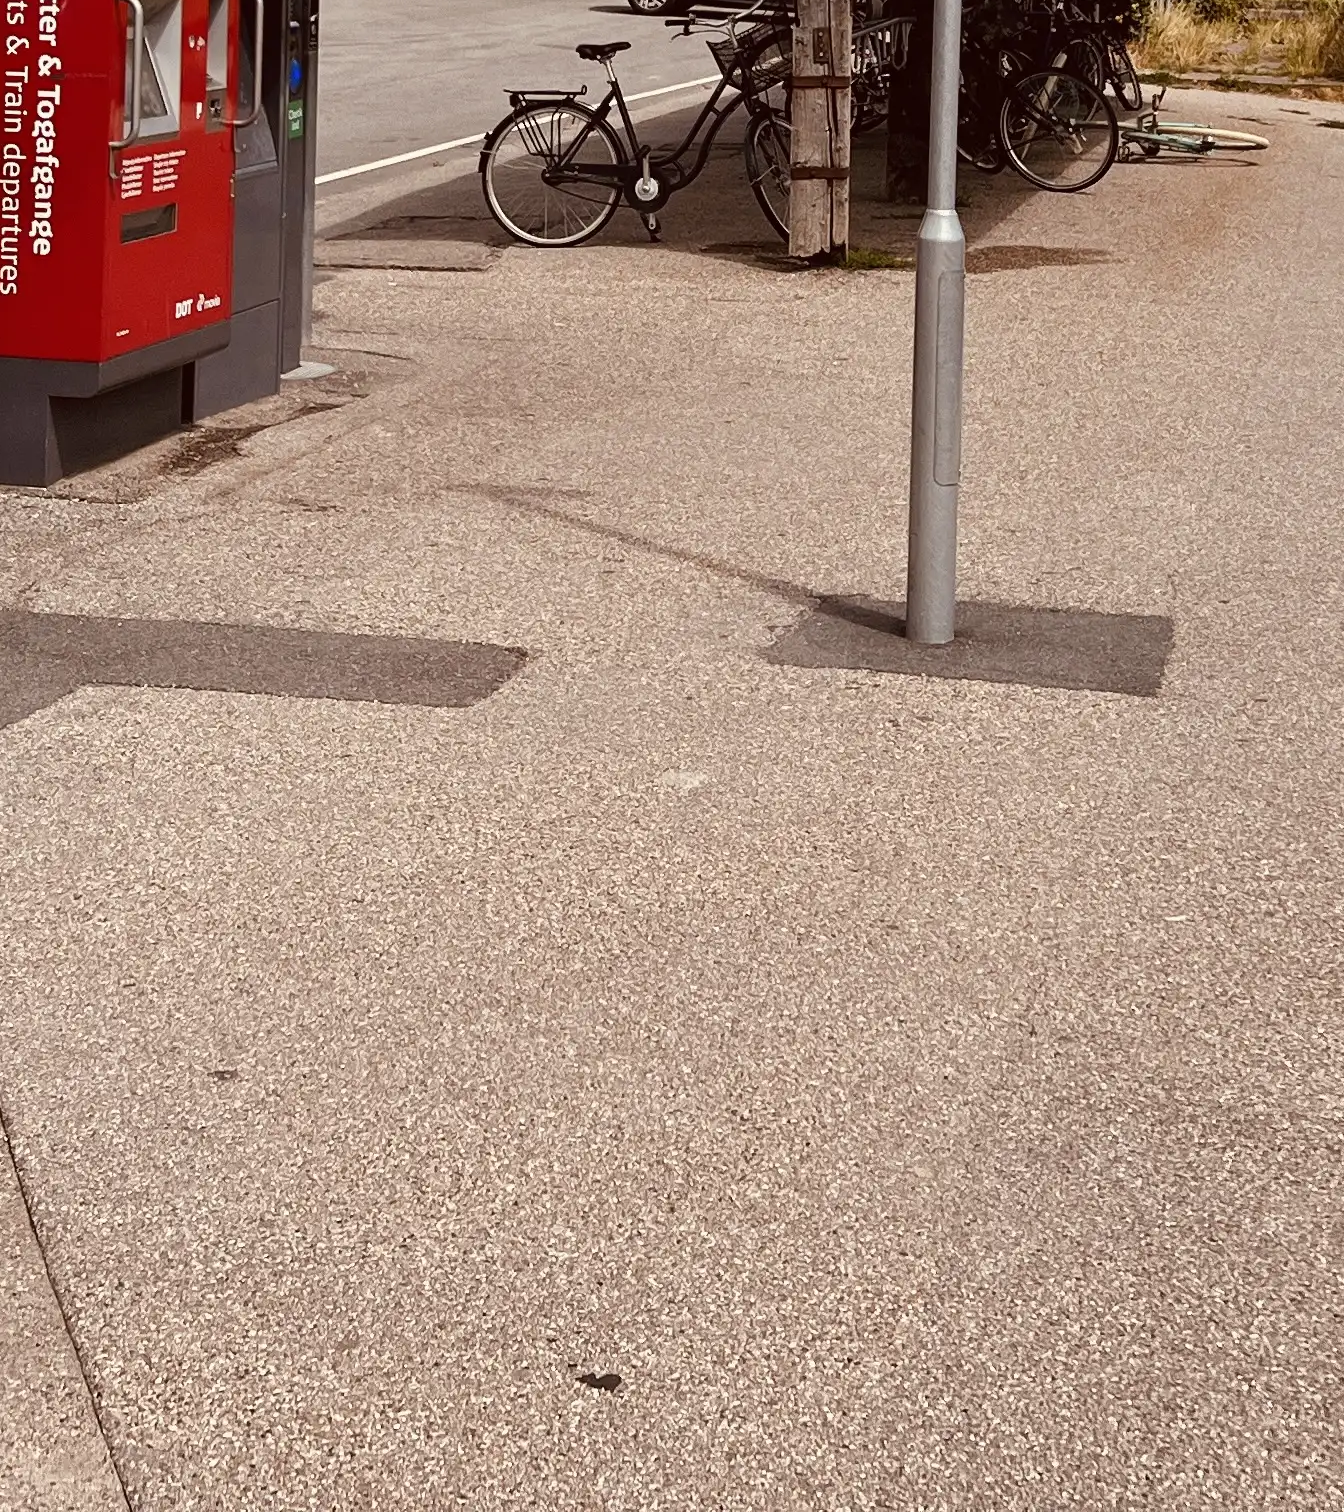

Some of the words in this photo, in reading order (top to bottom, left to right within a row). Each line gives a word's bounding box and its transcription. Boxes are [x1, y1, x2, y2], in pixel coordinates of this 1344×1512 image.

[5, 35, 30, 55] &
[37, 54, 62, 77] &
[3, 65, 29, 133] Train
[28, 84, 61, 256] Togafgange
[175, 298, 194, 319] DOT
